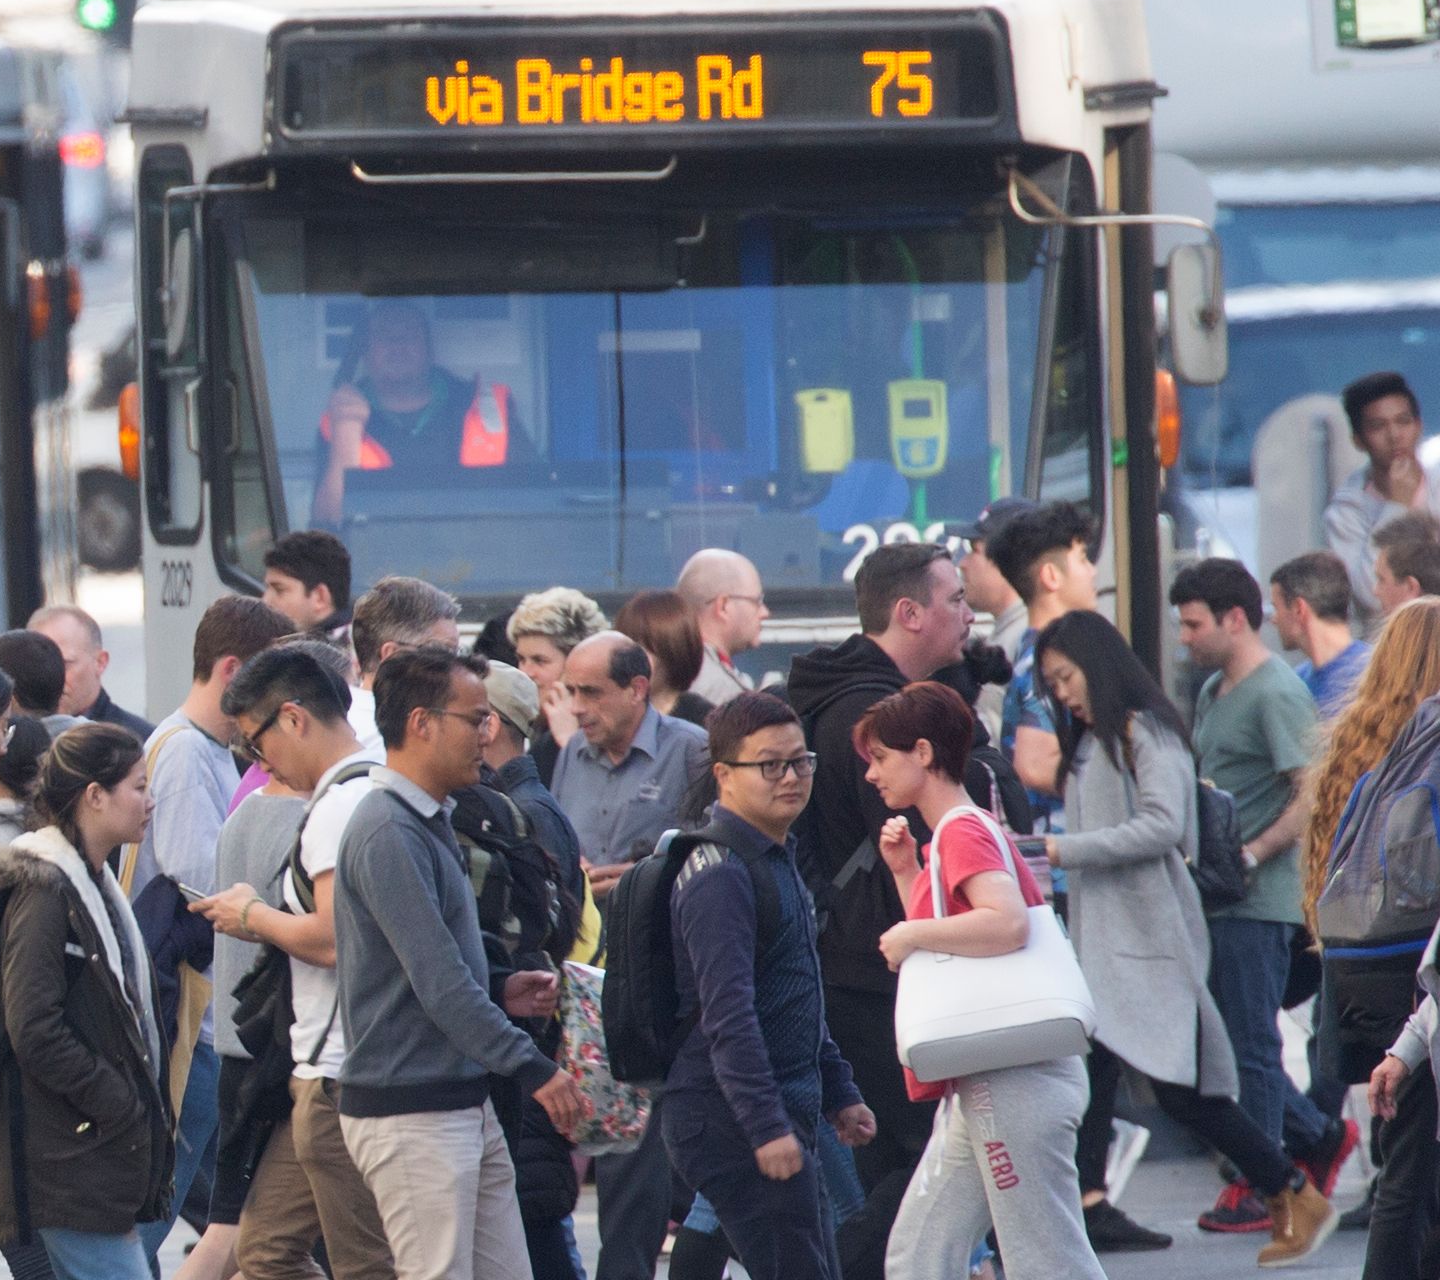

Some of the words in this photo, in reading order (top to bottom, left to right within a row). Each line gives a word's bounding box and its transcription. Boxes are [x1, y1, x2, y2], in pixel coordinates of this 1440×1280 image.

[426, 59, 504, 125] via
[515, 56, 685, 124] Bridge
[697, 54, 764, 119] Rd
[862, 50, 932, 117] 75
[161, 560, 193, 608] 2029
[984, 1140, 1020, 1191] AERO
